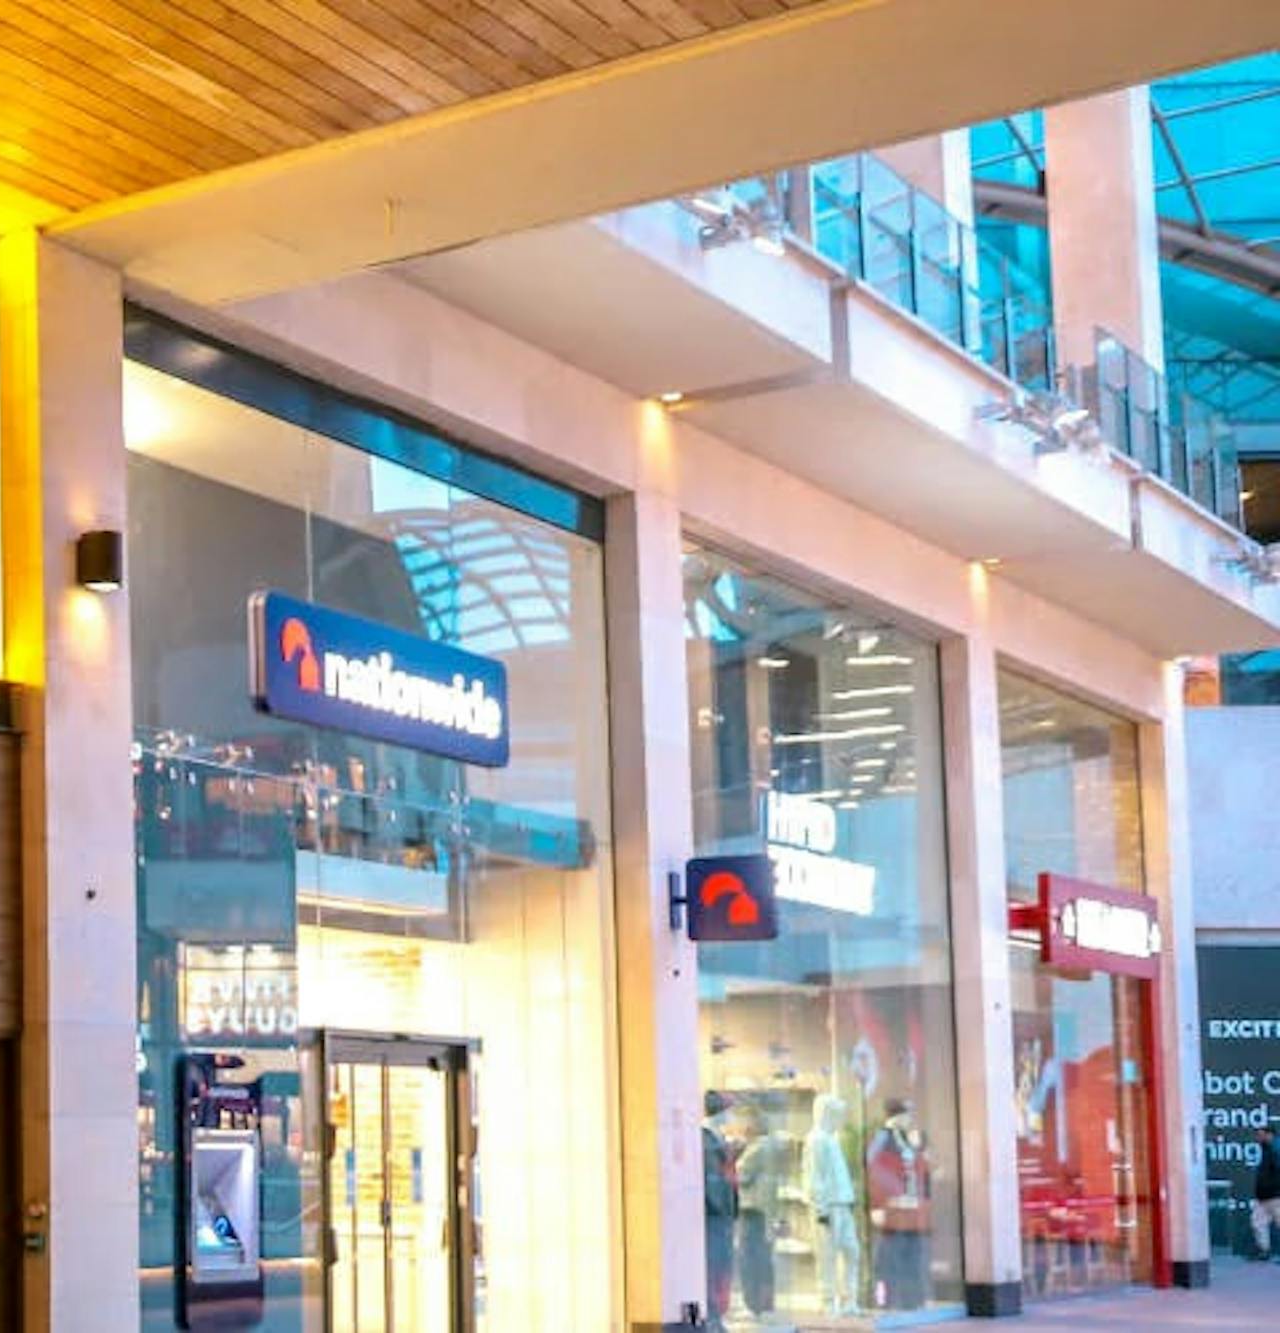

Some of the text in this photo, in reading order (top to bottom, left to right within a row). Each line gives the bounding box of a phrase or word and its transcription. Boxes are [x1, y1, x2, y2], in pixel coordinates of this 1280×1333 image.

[324, 652, 502, 740] nationwide
[1204, 1070, 1256, 1095] bot
[1202, 1102, 1280, 1129] rand-
[1204, 1135, 1263, 1168] ning
